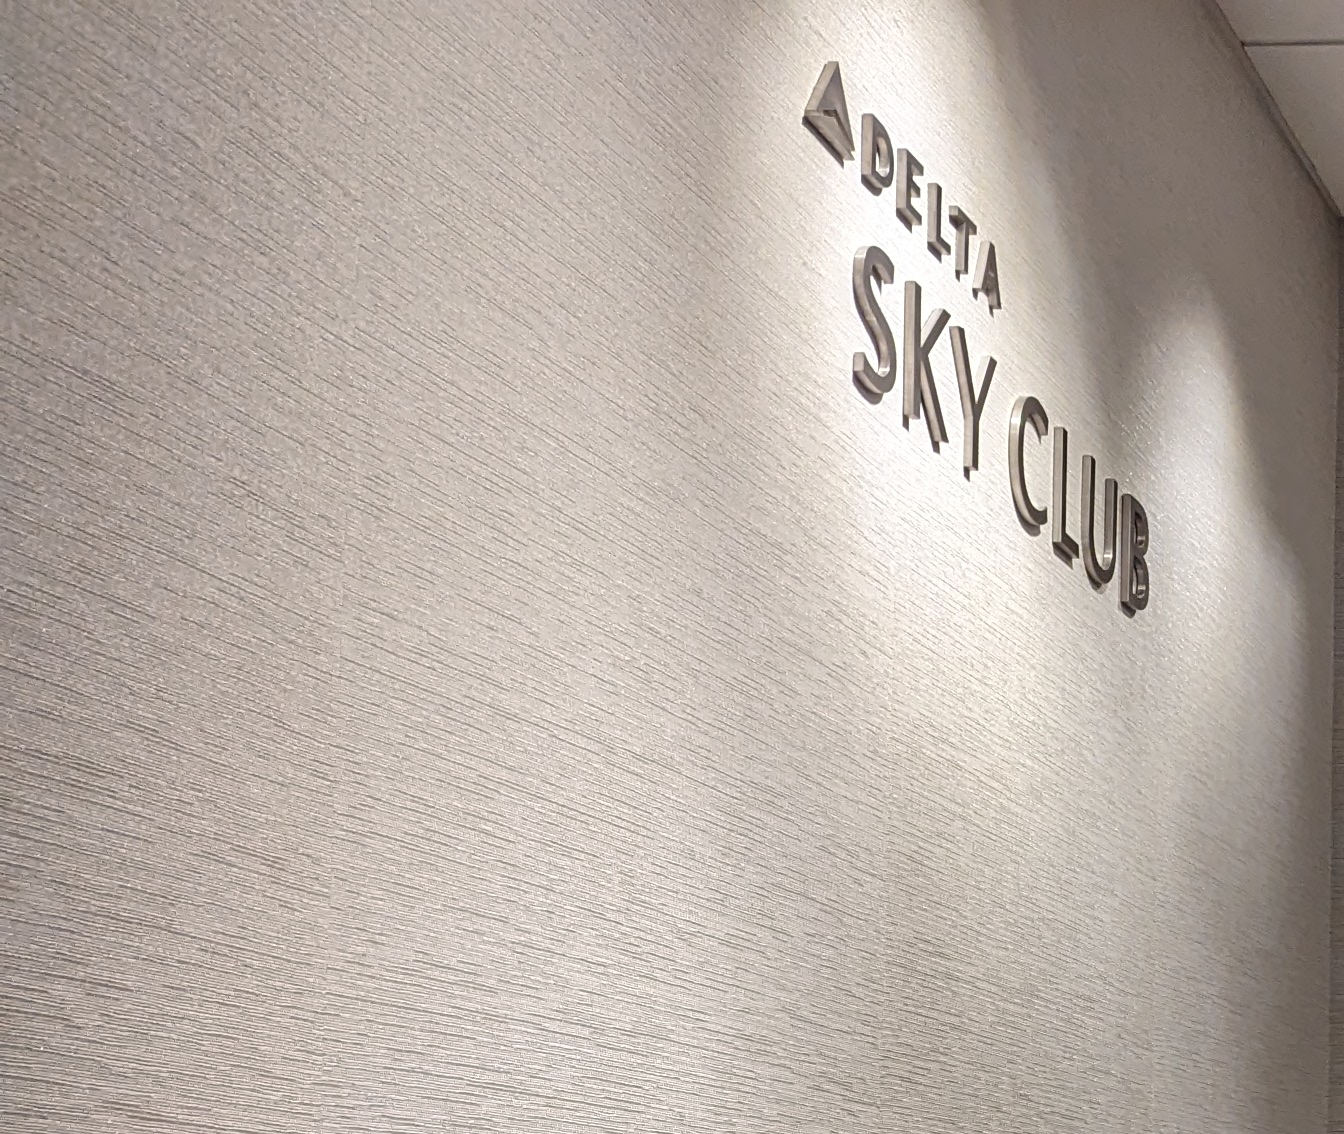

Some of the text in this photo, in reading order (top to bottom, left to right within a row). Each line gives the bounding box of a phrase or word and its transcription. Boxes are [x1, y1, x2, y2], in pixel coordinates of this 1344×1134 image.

[861, 112, 1001, 311] DELTA
[852, 245, 1150, 612] SKY CLUB
